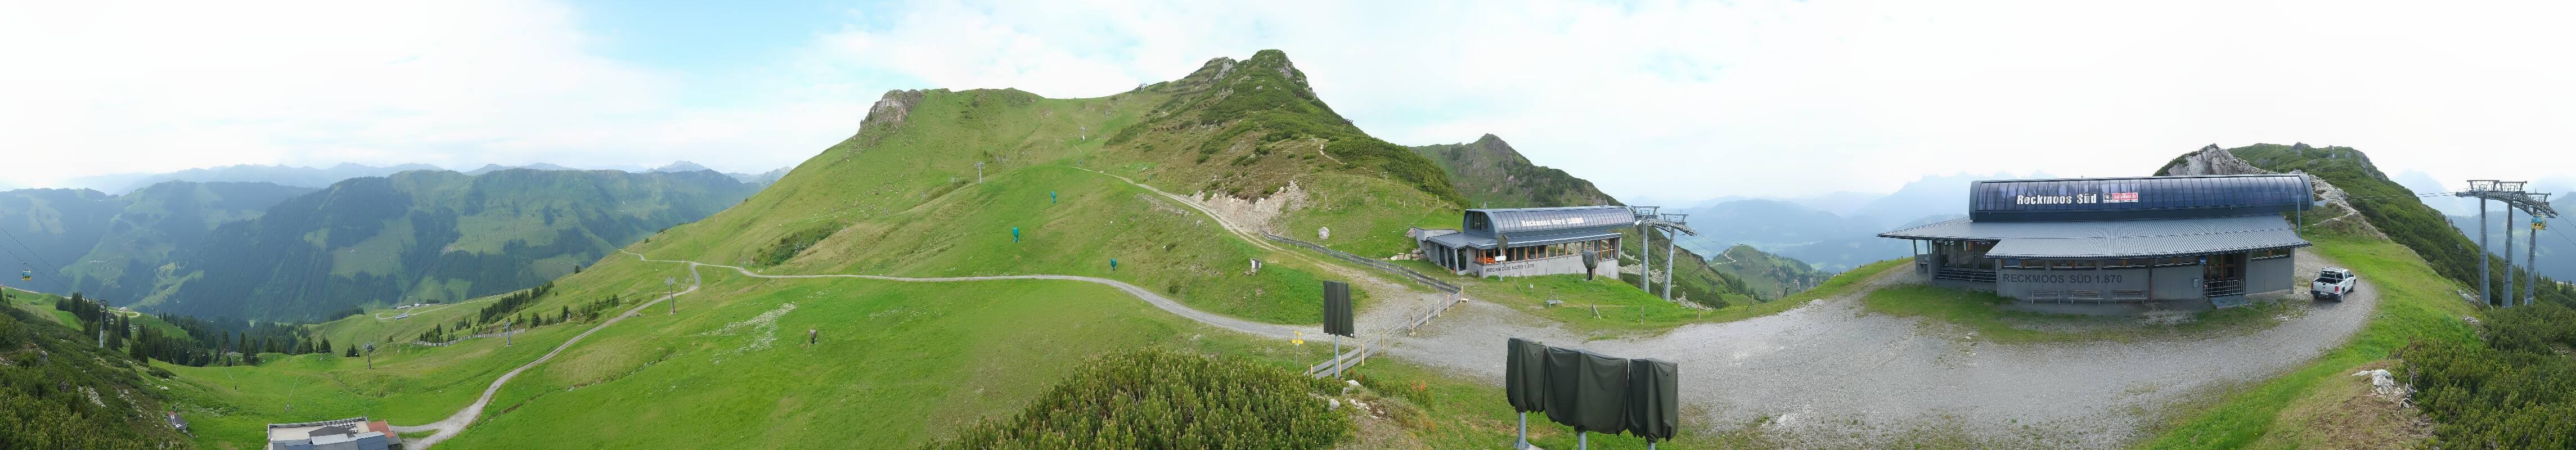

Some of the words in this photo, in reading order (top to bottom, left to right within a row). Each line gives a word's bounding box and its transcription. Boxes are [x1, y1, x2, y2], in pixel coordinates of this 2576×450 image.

[2017, 195, 2072, 204] Reckmoos
[2077, 194, 2097, 204] Süd
[2003, 273, 2065, 284] RECKMOOS
[2070, 274, 2092, 284] SÜD
[2095, 274, 2123, 284] 1.870
